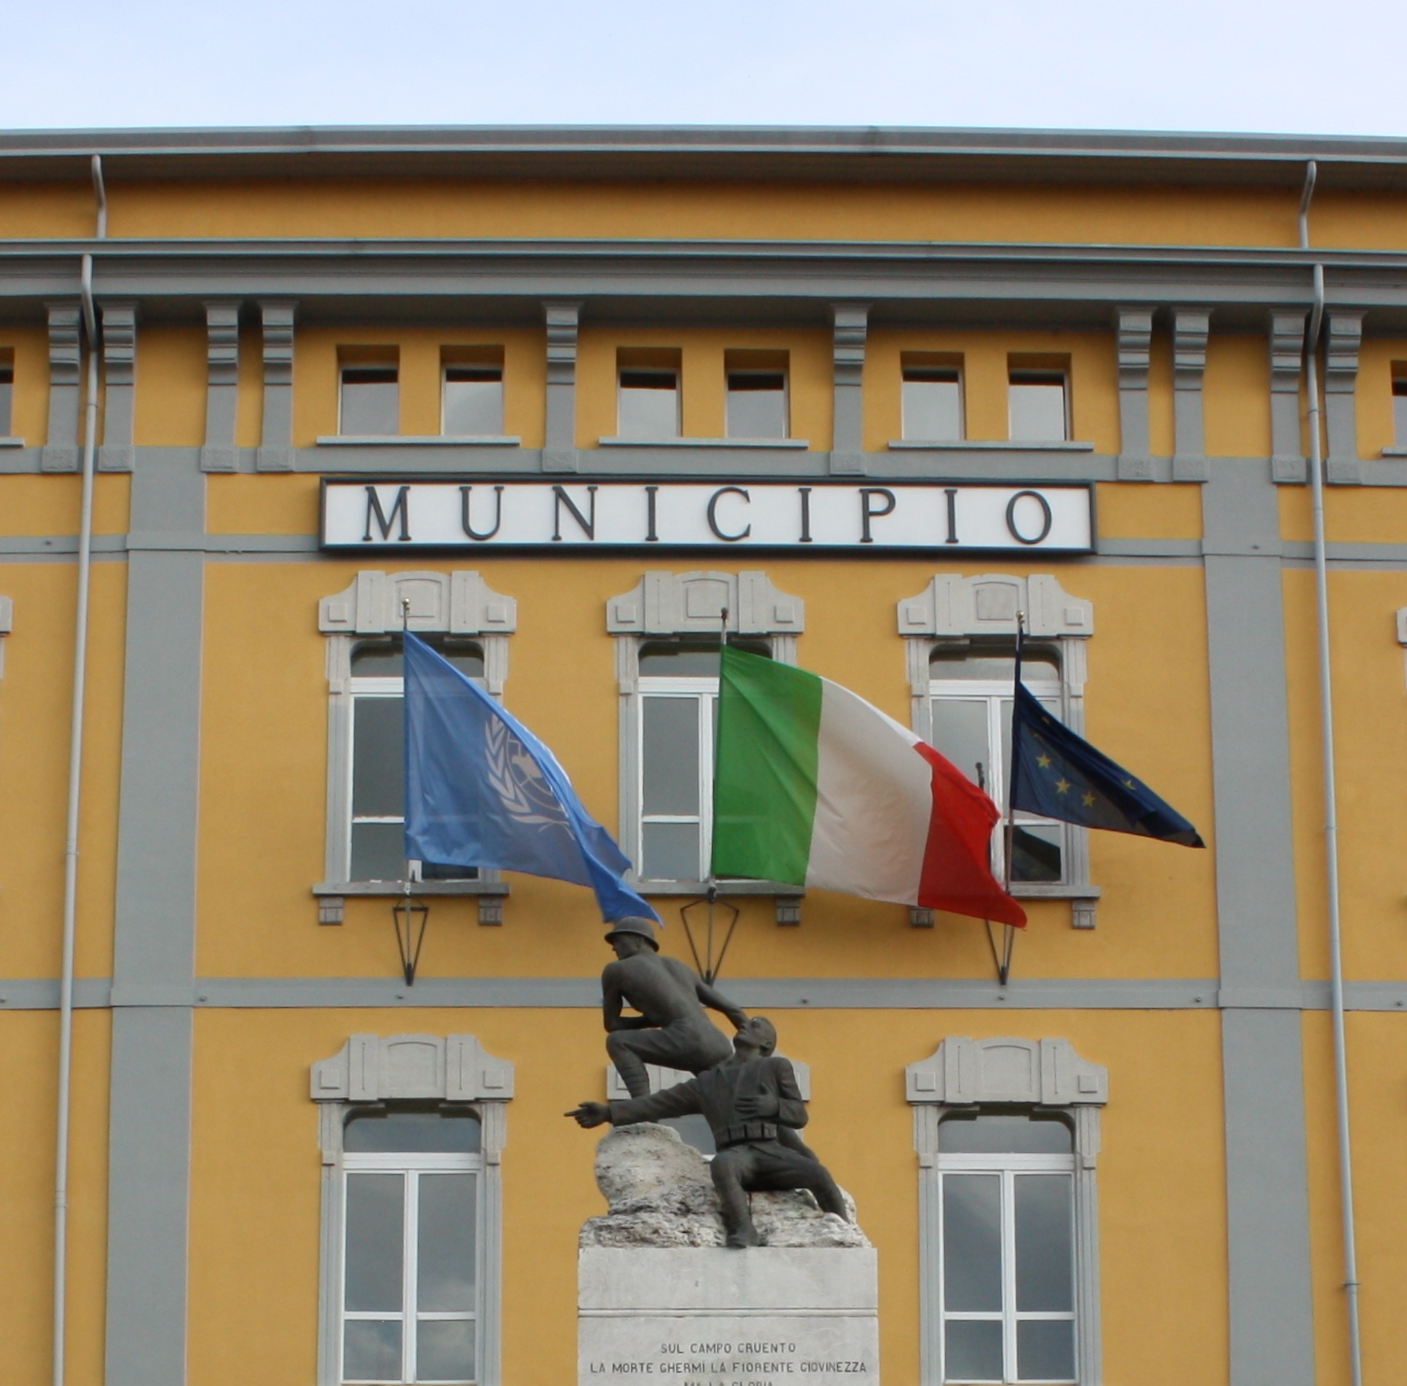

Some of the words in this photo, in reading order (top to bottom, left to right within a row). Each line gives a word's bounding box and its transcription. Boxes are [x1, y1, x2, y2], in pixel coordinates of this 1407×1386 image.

[363, 486, 1054, 544] MUNICIPIO
[661, 1343, 684, 1354] SUL
[690, 1343, 732, 1354] CAMPO
[738, 1343, 796, 1354] CRUENTO
[590, 1362, 606, 1374] LA
[612, 1362, 653, 1374] MORTE
[711, 1362, 726, 1374] LA
[733, 1362, 794, 1374] FIORENTE
[800, 1362, 867, 1374] GIOVINEZZA
